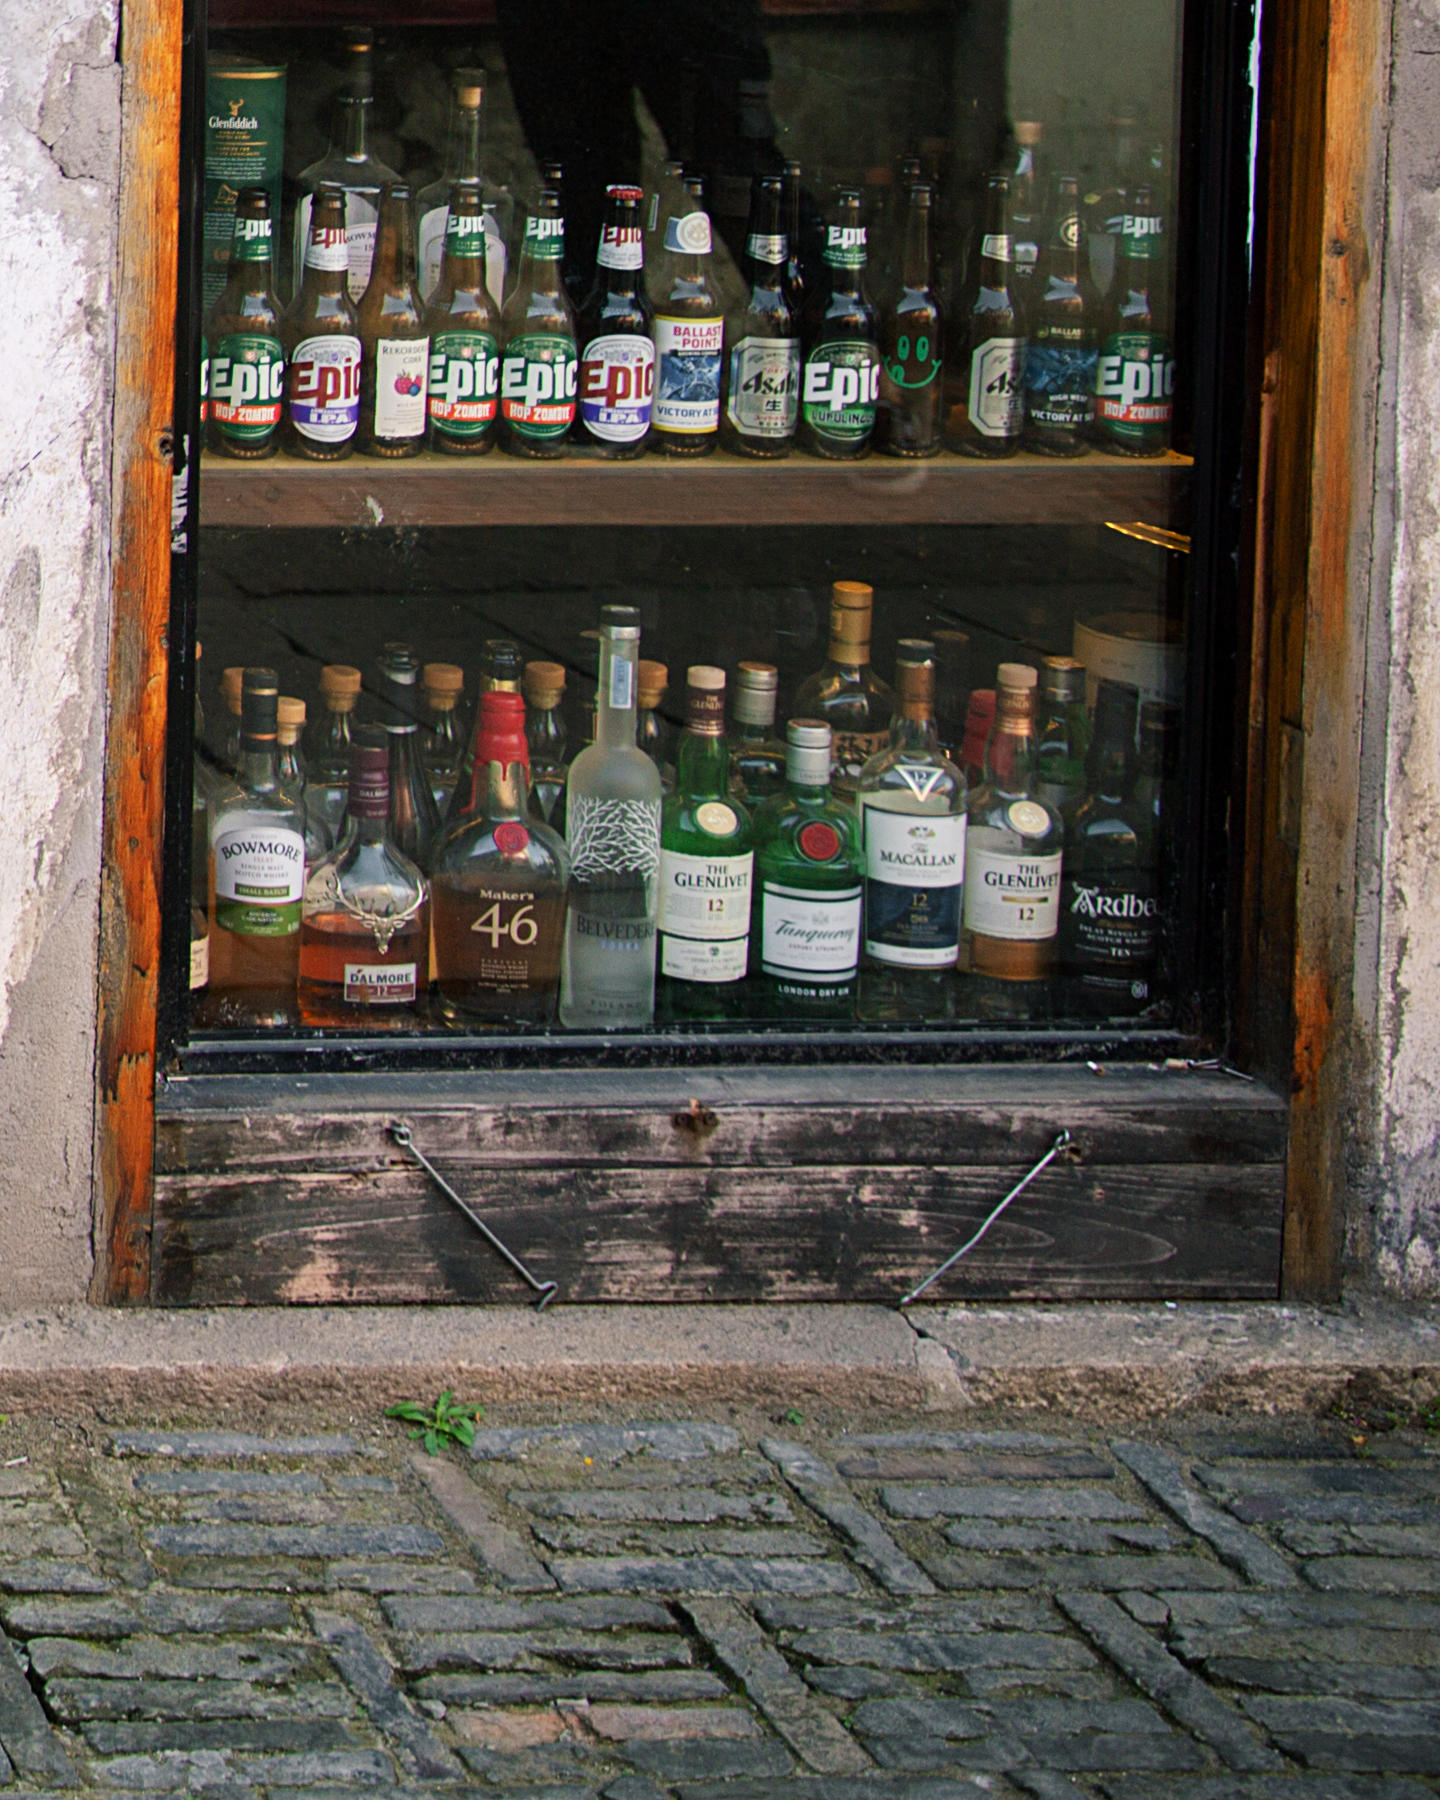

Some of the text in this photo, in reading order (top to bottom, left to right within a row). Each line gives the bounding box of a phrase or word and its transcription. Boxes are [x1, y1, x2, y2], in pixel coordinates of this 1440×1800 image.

[208, 116, 258, 130] Glenfiddich
[236, 218, 272, 239] Epic
[447, 215, 485, 236] Epic
[527, 217, 564, 237] Epic
[603, 226, 642, 247] Epic
[827, 225, 867, 247] Epic
[673, 325, 722, 338] BALLAST
[682, 337, 717, 349] POINT
[211, 357, 282, 407] Epic
[290, 357, 361, 408] Epic
[428, 356, 498, 407] Epic
[502, 357, 578, 408] Epic
[582, 358, 655, 407] Epic
[803, 360, 880, 411] Epic
[1096, 354, 1177, 406] Epic
[214, 405, 274, 421] HOP ZOMBIE
[430, 403, 491, 420] HOP ZOMBIE
[509, 404, 570, 421] HOP ZOMBIE
[657, 405, 713, 417] VICTORY AT
[1031, 408, 1072, 422] VICTORY
[1104, 401, 1169, 419] HOP ZOMBIE
[221, 840, 301, 864] BOWMORE
[880, 851, 957, 868] MACALLAN
[706, 864, 729, 874] THE
[1018, 864, 1040, 874] THE
[674, 872, 748, 888] GLENLIVET
[984, 872, 1059, 888] GLENLIVET
[479, 889, 535, 901] Maker's
[912, 893, 927, 906] 12
[707, 899, 725, 912] 12
[1018, 908, 1034, 921] 12
[470, 903, 539, 948] 46
[776, 920, 854, 941] Tanqueray
[1110, 947, 1132, 957] TEN
[350, 971, 412, 984] DALMORE
[779, 986, 811, 996] LONDON
